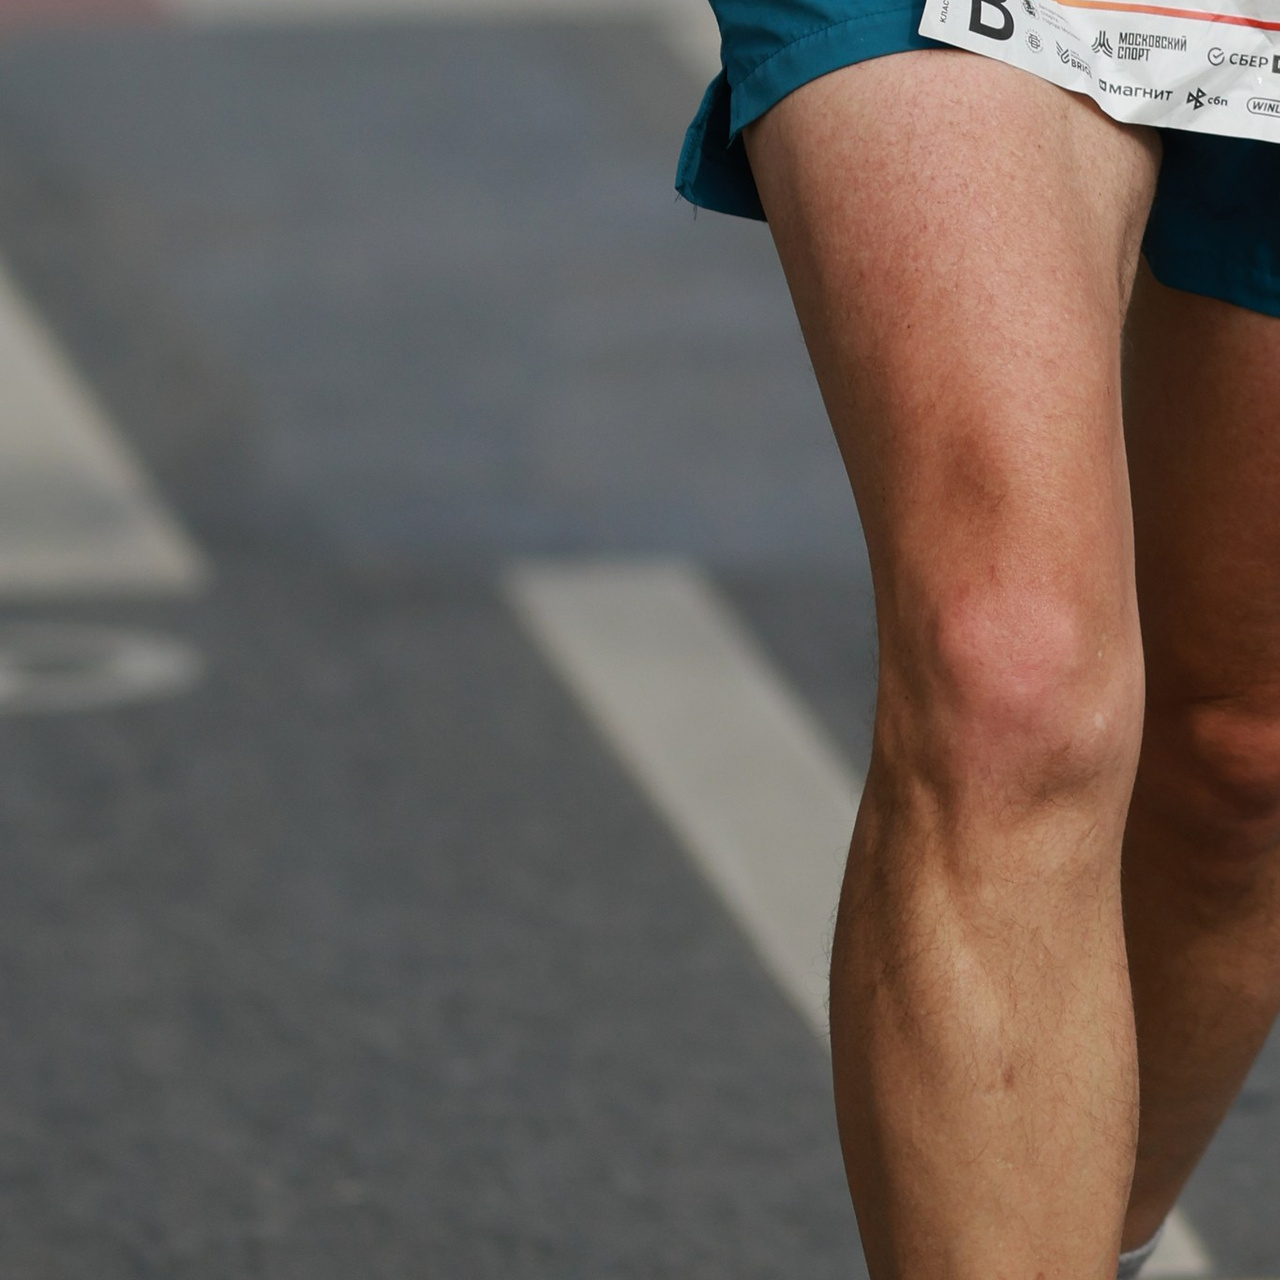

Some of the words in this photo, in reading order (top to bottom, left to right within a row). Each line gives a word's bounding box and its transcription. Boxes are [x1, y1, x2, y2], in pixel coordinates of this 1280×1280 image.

[1118, 31, 1187, 52] МОСКОВСКИЙ
[1117, 48, 1151, 62] СПОРТ
[1229, 52, 1269, 68] СБЕР
[1108, 83, 1174, 101] магнит
[1207, 95, 1228, 106] сбп
